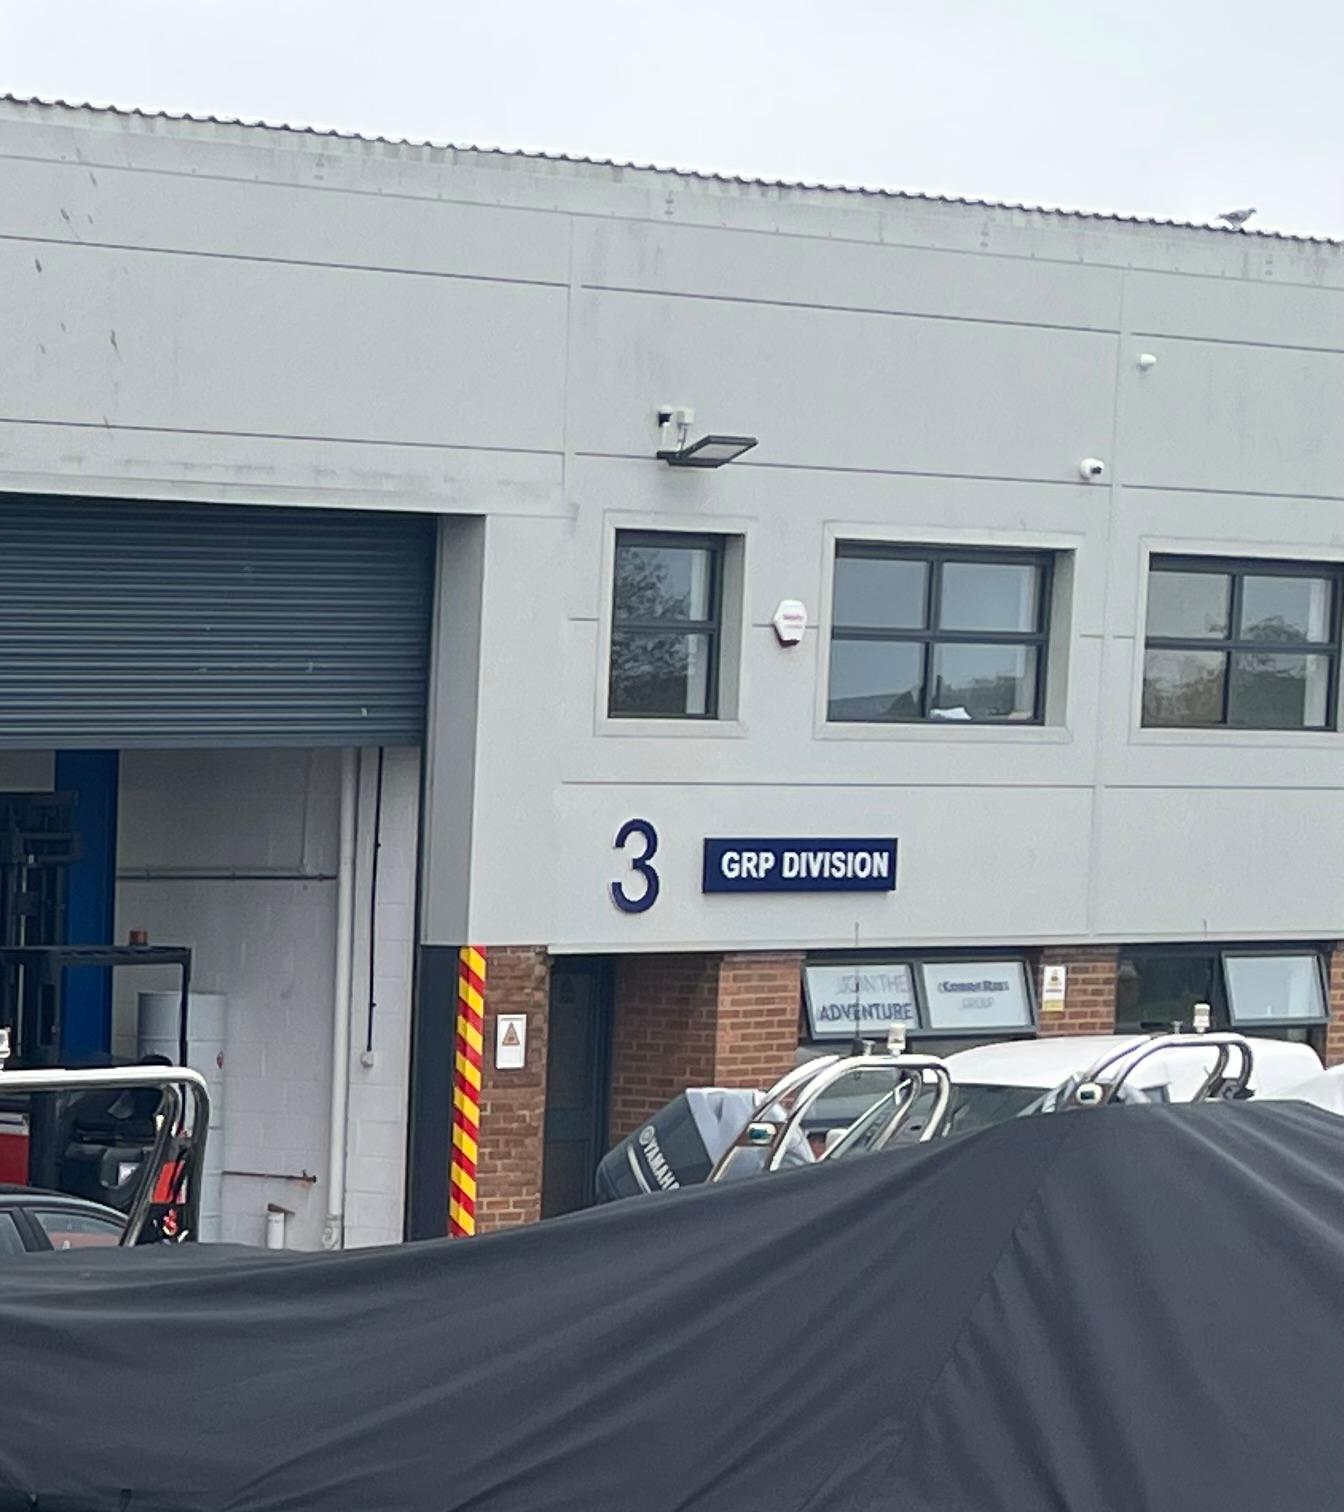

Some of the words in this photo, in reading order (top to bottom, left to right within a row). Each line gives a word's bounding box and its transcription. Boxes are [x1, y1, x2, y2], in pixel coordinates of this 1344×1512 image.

[611, 818, 660, 914] 3
[721, 851, 776, 878] GRP
[782, 851, 890, 878] DIVISION
[819, 1002, 913, 1021] ADVENTURE
